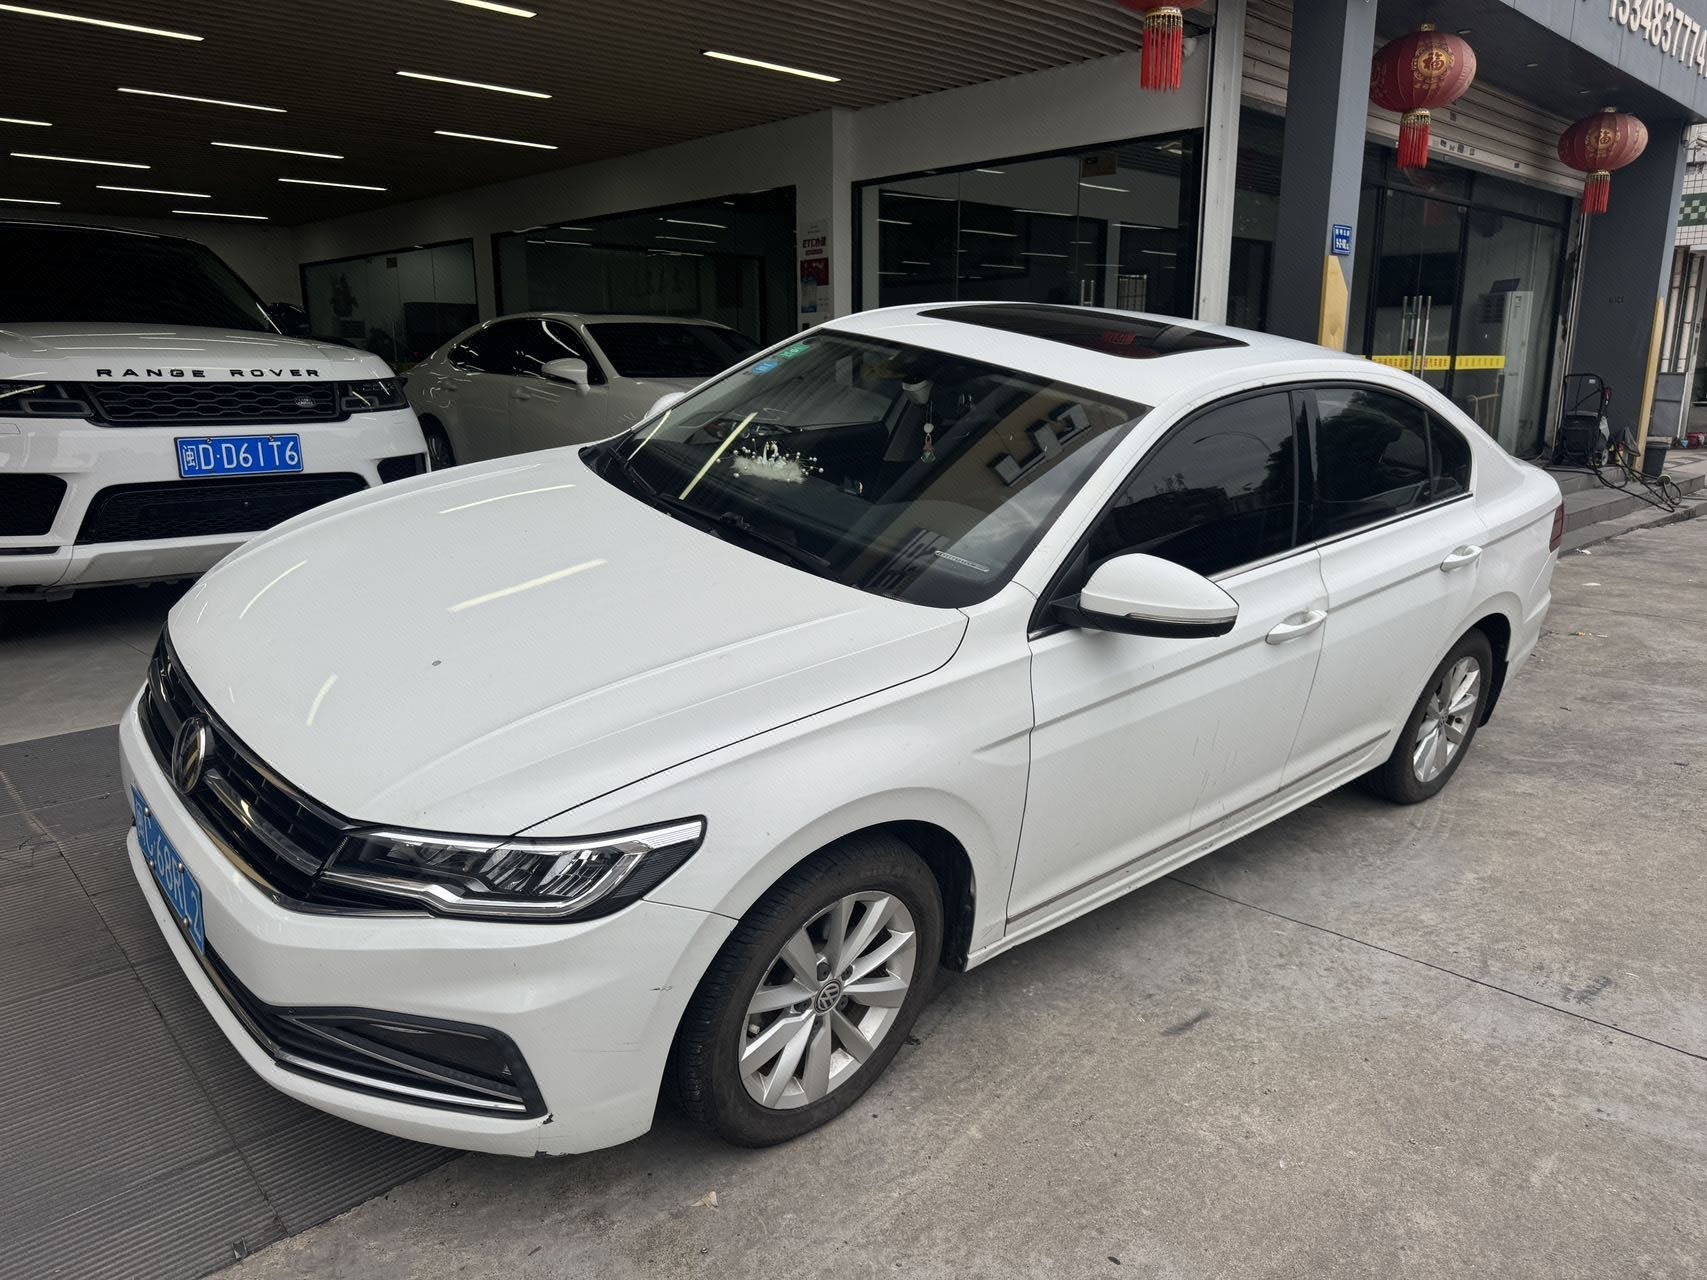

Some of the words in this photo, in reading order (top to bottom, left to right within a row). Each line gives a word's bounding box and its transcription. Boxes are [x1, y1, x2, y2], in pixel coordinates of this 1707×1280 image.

[1609, 0, 1707, 78] 34837774
[96, 368, 206, 378] RANGE
[229, 368, 320, 378] ROVER
